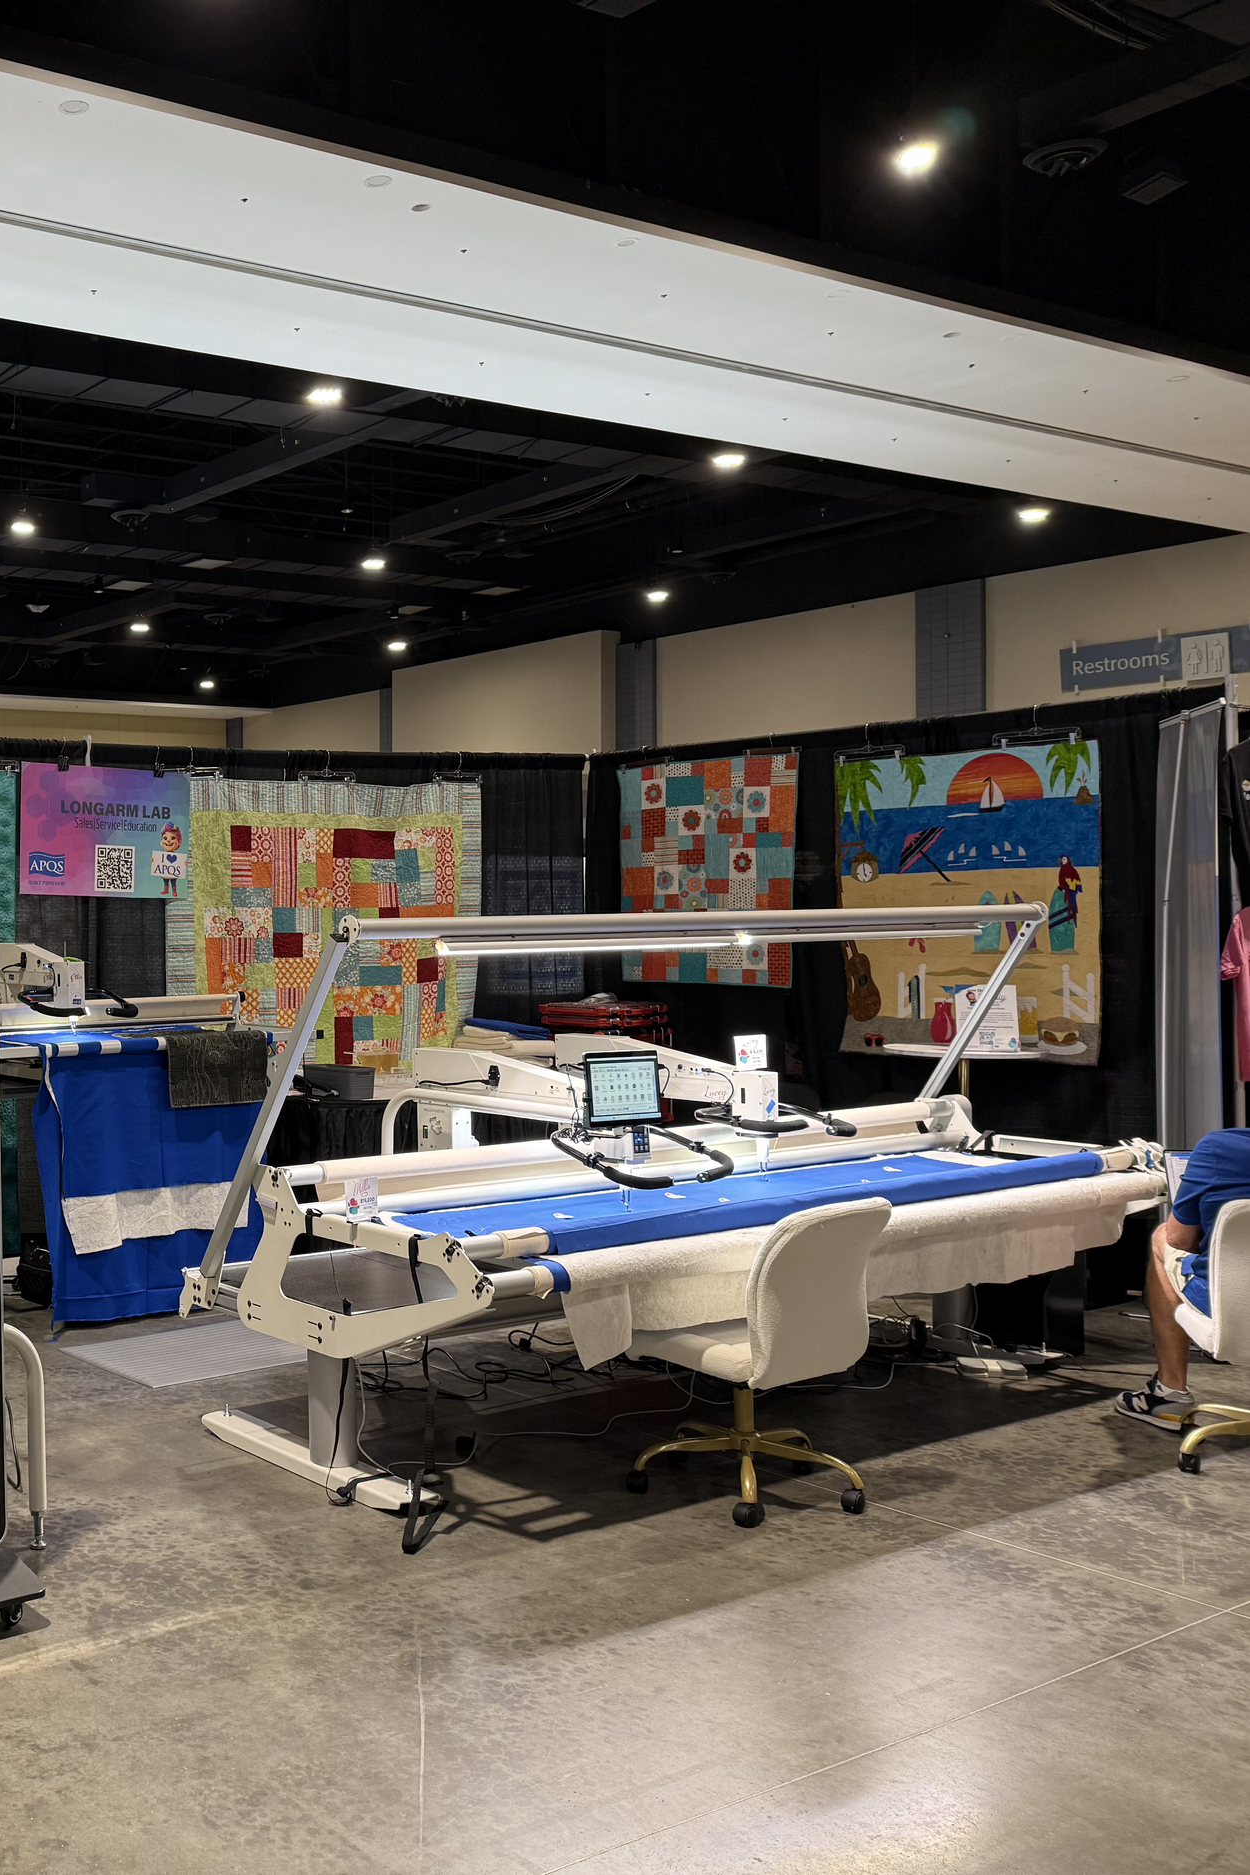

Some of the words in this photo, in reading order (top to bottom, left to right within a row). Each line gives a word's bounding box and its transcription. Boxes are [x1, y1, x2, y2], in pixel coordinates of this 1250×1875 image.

[1072, 652, 1170, 676] Restrooms
[60, 800, 139, 818] LONGARM
[142, 805, 171, 819] LAB
[28, 858, 65, 876] APQS
[154, 864, 181, 878] APQS
[705, 1085, 728, 1100] Lucey
